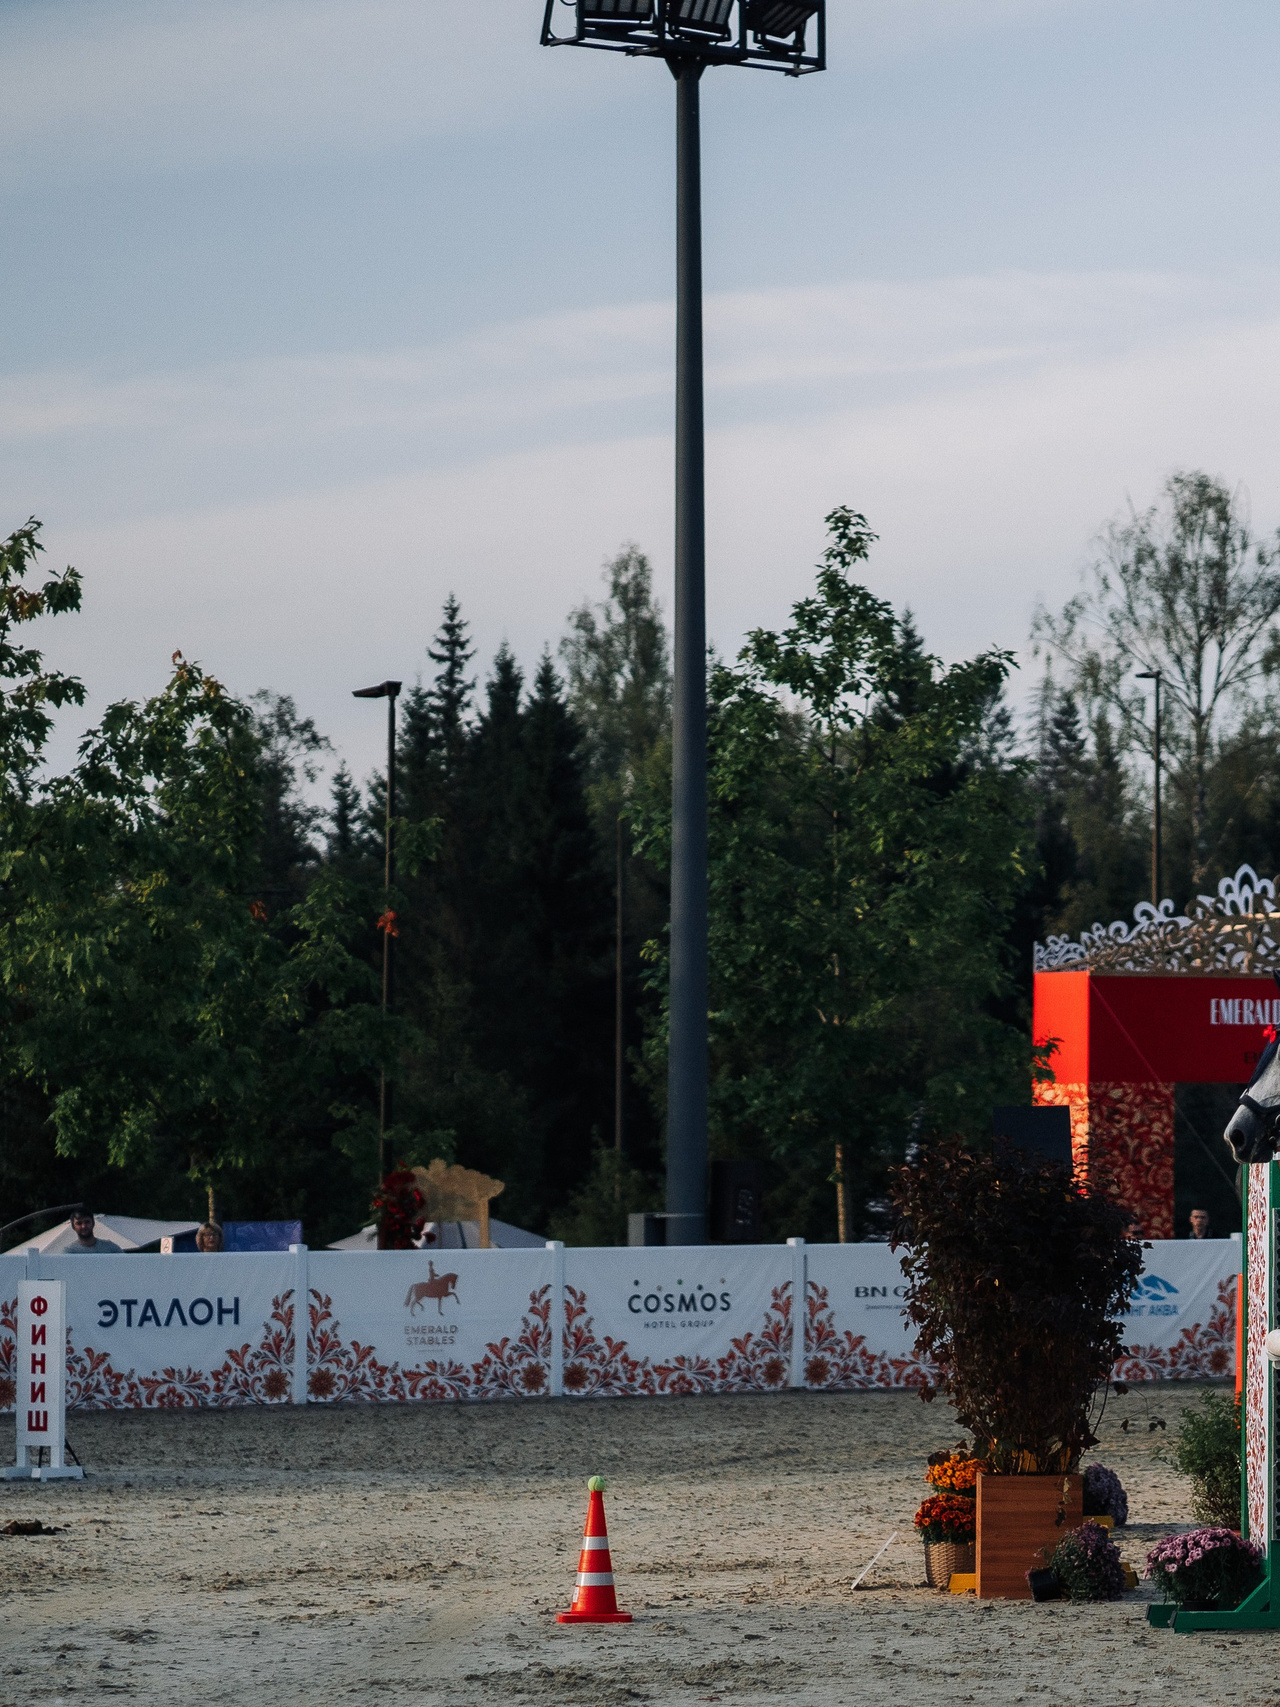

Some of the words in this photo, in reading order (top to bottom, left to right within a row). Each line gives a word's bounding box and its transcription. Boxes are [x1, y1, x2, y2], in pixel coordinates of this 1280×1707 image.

[855, 1286, 887, 1297] BN
[628, 1292, 731, 1314] COSMOS
[97, 1297, 240, 1327] ЭТАЛОН
[404, 1325, 458, 1335] EMERALD
[644, 1321, 676, 1329] HOTEL
[680, 1320, 714, 1328] GROUP
[406, 1336, 455, 1345] STABLES
[27, 1296, 48, 1432] ФИНИШ
